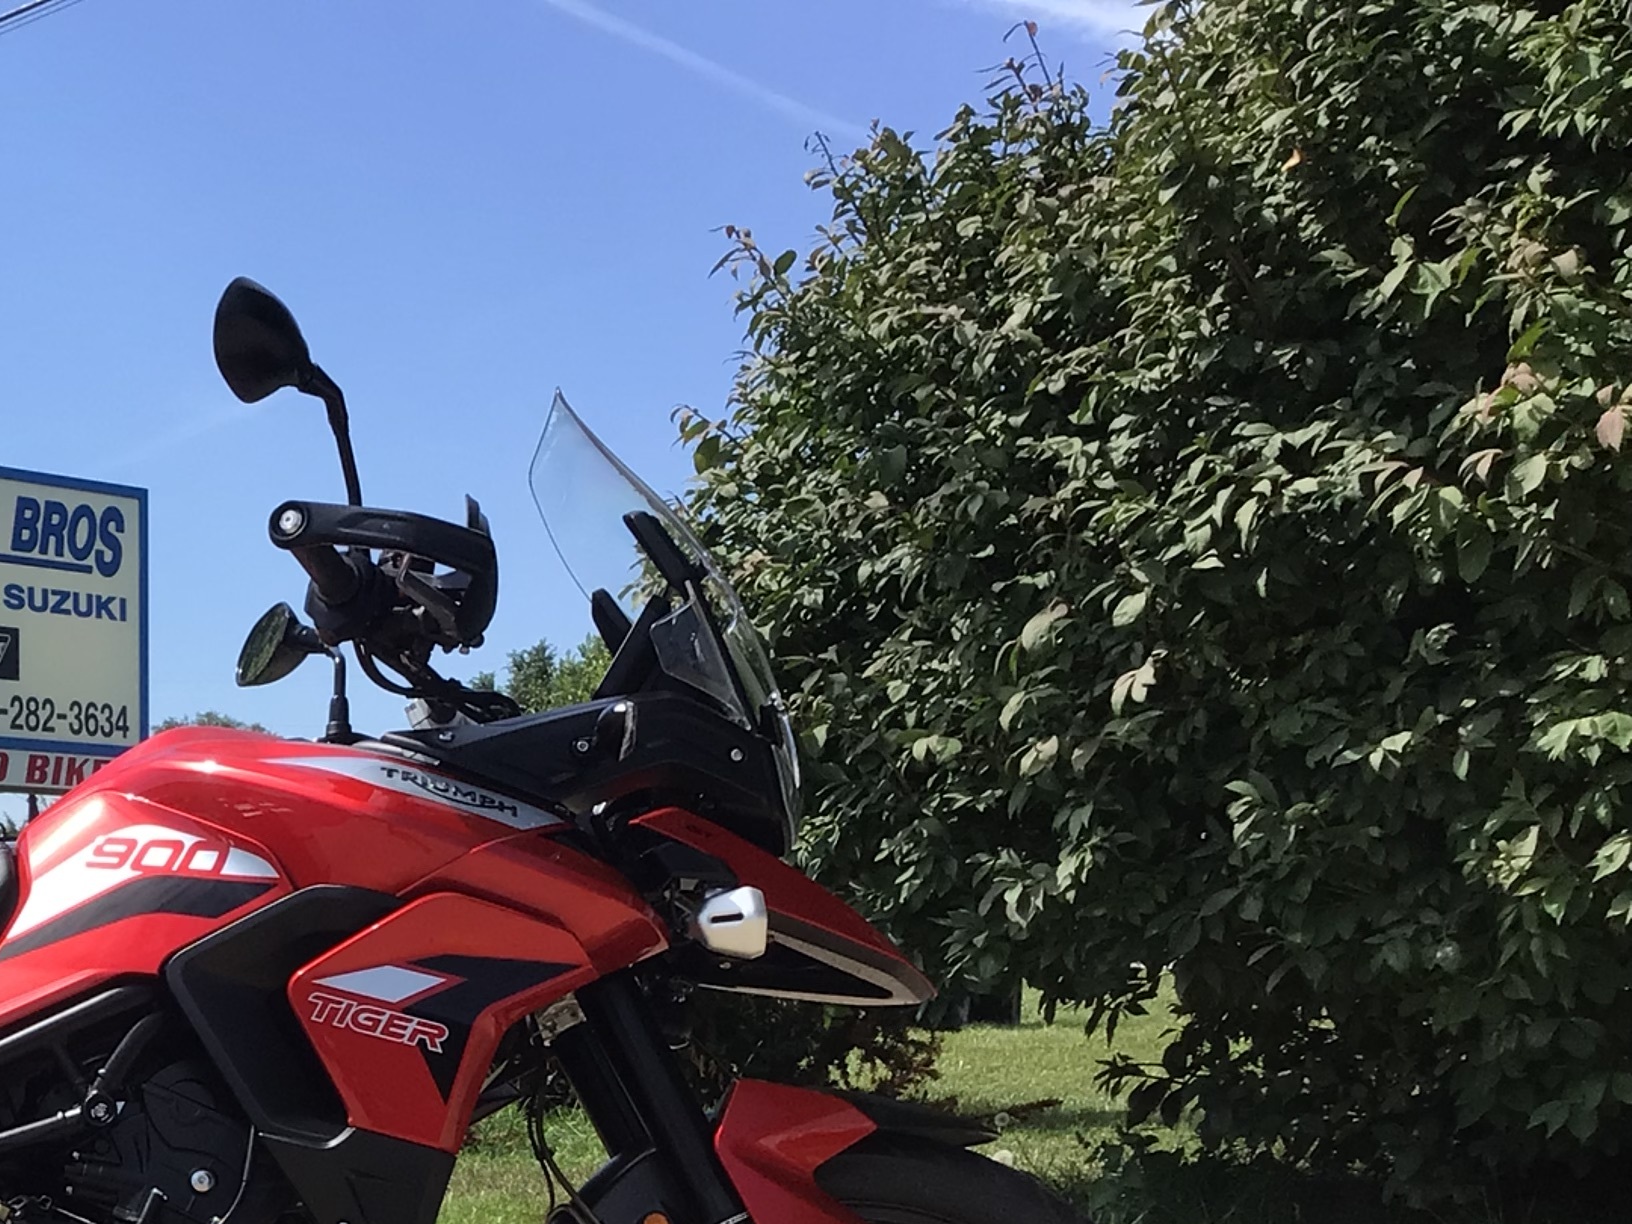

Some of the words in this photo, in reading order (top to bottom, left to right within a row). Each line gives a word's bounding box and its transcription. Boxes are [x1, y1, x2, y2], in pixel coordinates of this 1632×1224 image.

[11, 496, 125, 578] BROS
[3, 583, 127, 622] SUZUKI
[380, 767, 518, 818] TRIUMPH
[85, 837, 230, 875] 900
[307, 992, 450, 1054] TIGER
